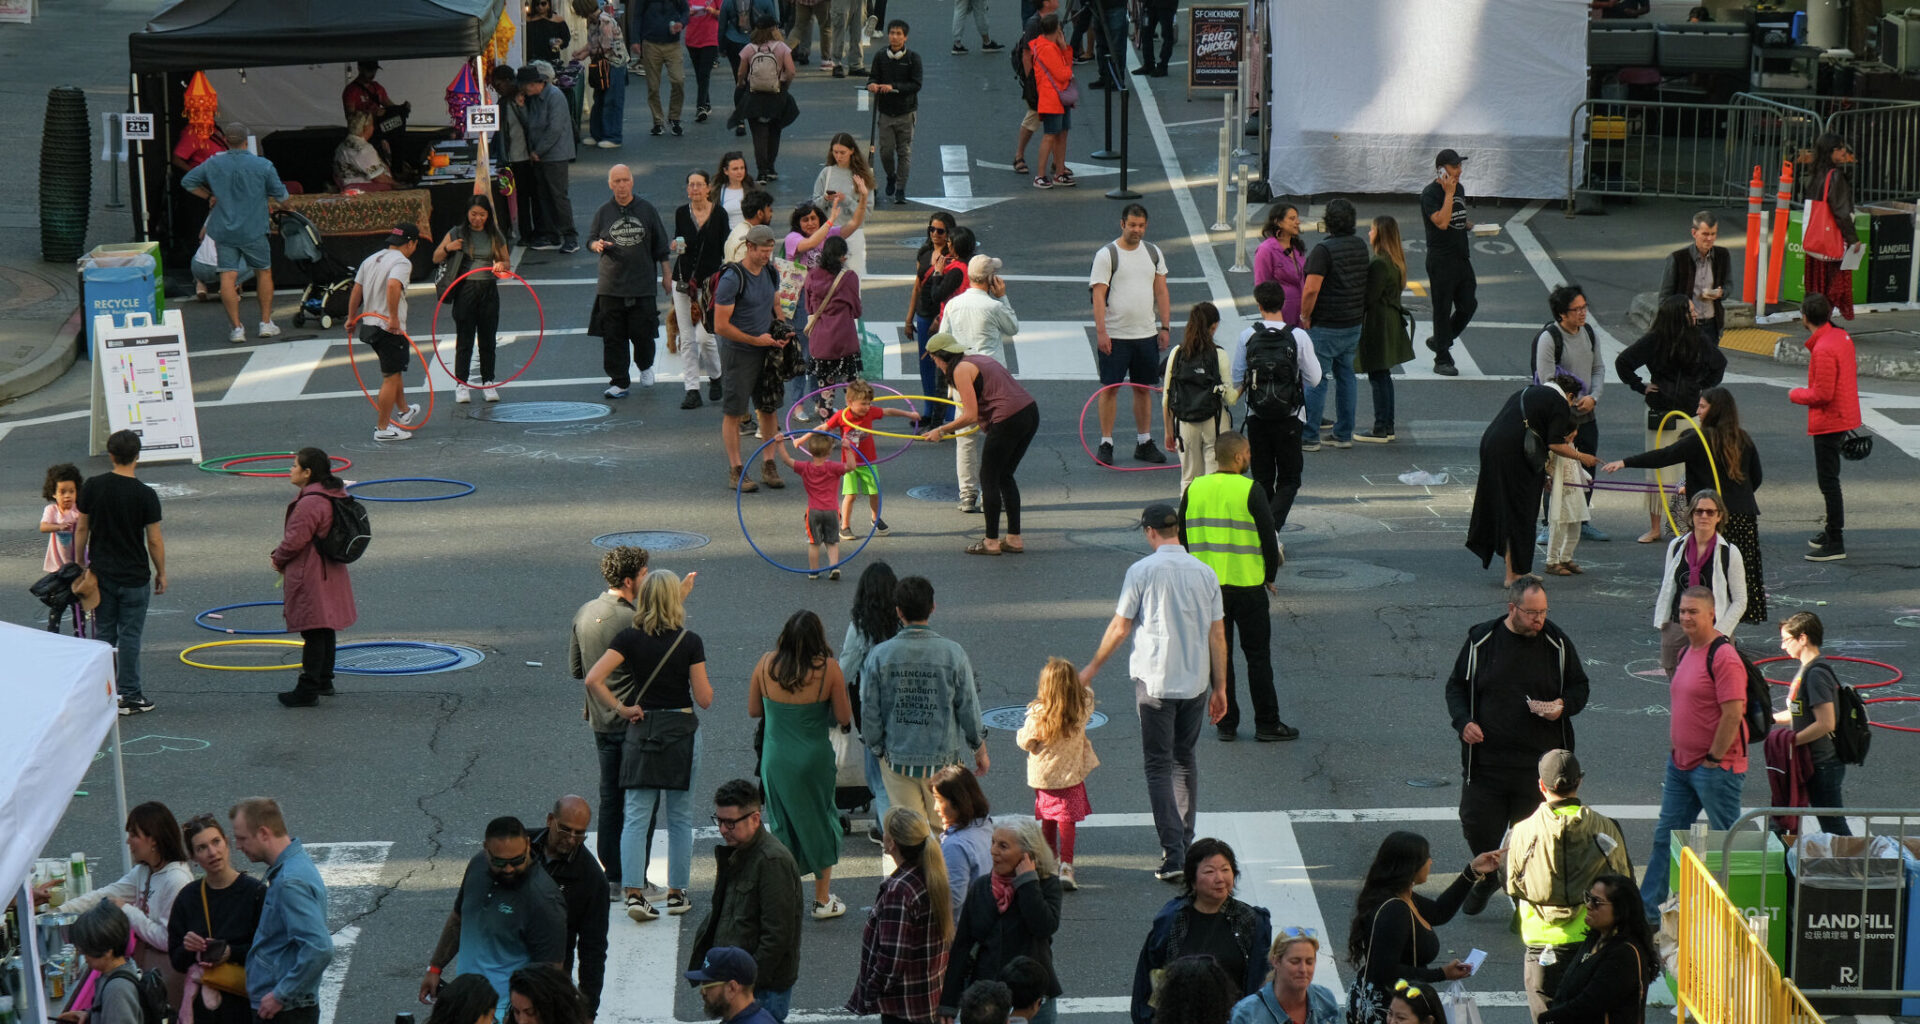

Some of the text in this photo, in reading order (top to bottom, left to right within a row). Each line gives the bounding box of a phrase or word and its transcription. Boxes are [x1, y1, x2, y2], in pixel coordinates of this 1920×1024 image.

[1202, 32, 1232, 44] FRIED
[1197, 40, 1238, 56] CHICKEN
[474, 114, 494, 124] 21+
[129, 122, 147, 132] 21+
[1879, 244, 1911, 254] LANDFILL
[94, 298, 140, 309] RECYCLE
[891, 670, 938, 679] BALENCIAGA
[1808, 914, 1893, 929] LANDFILL
[1854, 931, 1896, 941] Bsurero
